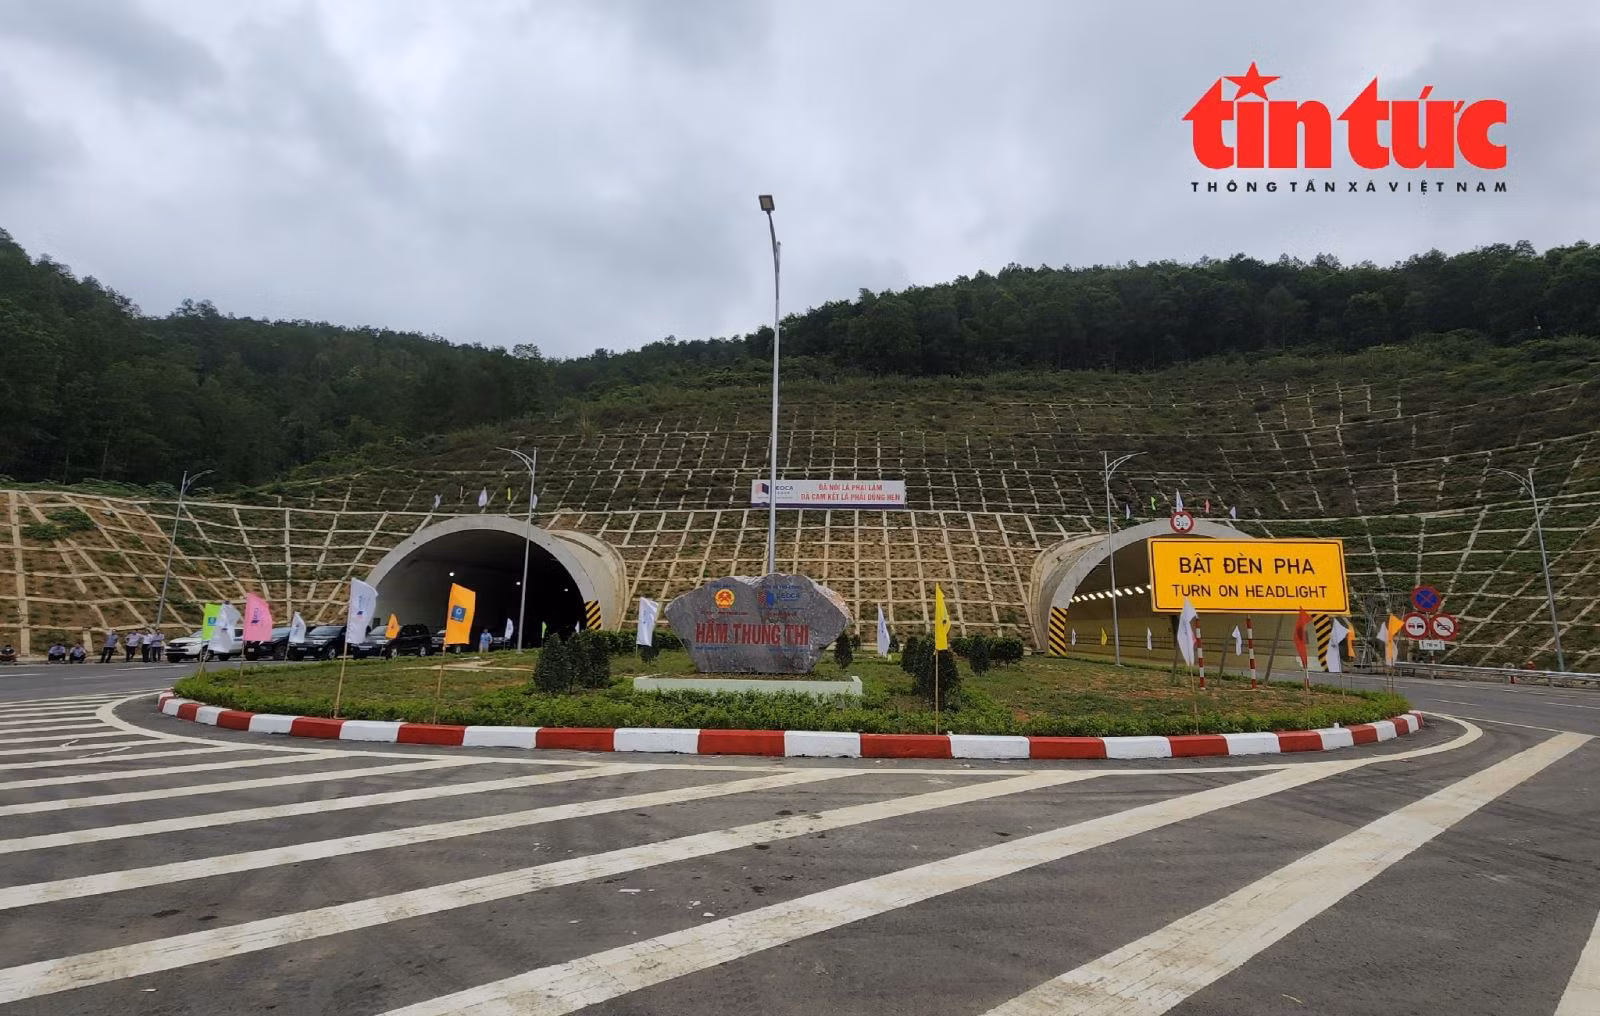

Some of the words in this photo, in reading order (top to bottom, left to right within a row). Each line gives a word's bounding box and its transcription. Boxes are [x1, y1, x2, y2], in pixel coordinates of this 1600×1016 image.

[1179, 553, 1214, 577] BẬT
[1223, 553, 1263, 575] ĐÈN
[1274, 558, 1316, 575] PHA
[1172, 584, 1211, 598] TURN
[1218, 584, 1239, 597] ON
[1245, 585, 1328, 599] HEADLIGHT
[732, 623, 781, 645] THUNG
